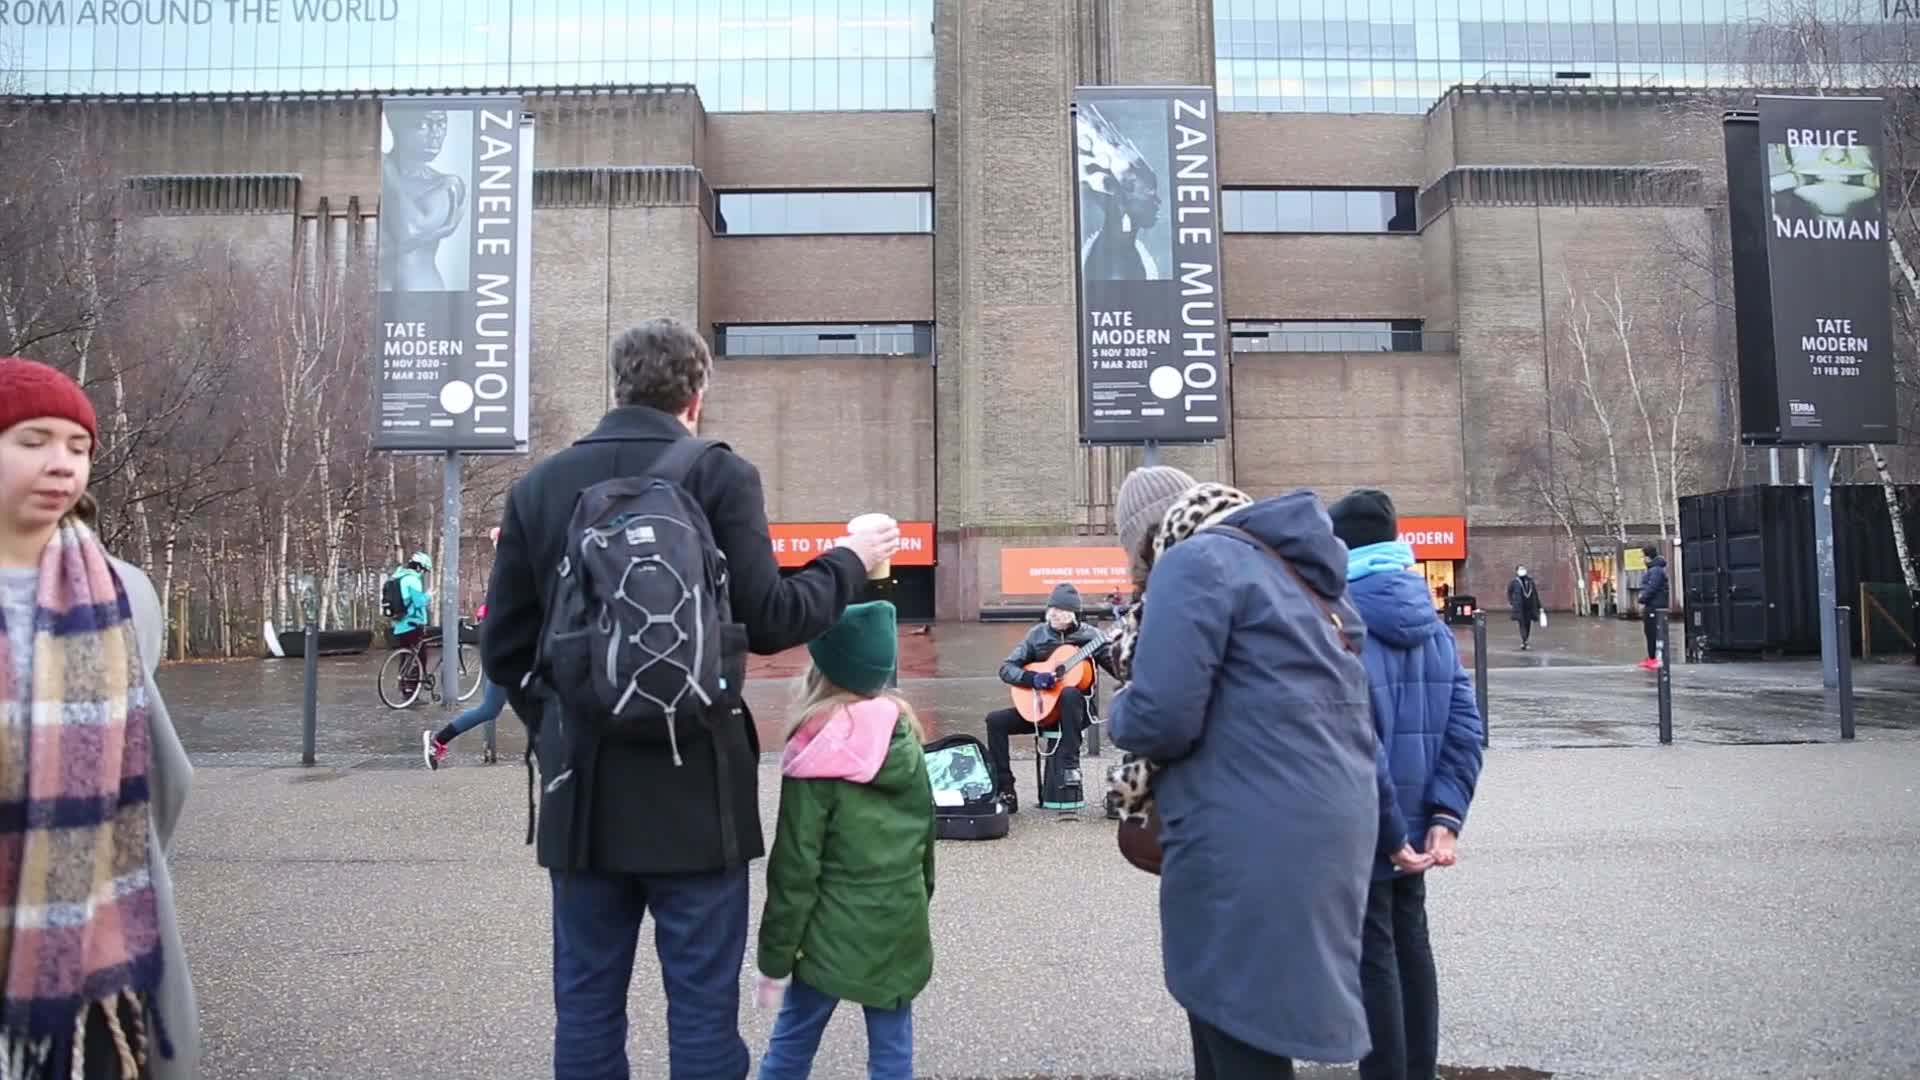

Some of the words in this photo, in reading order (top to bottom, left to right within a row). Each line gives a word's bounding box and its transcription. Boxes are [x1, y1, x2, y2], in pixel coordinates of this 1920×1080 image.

[76, 0, 213, 25] AROUND
[224, 0, 280, 24] THE
[292, 0, 399, 22] WORLD
[1787, 128, 1858, 149] BRUCE
[1174, 98, 1212, 244] ZANELE
[478, 110, 512, 255] ZANELE
[1776, 218, 1880, 241] NAUMAN
[1091, 311, 1133, 327] TATE
[1816, 318, 1852, 334] TATE
[384, 322, 426, 338] TATE
[1091, 329, 1171, 345] MODERN
[384, 340, 463, 356] MODERN
[1180, 262, 1218, 423] MUHOLI
[1801, 336, 1868, 352] MODERN
[473, 273, 510, 434] MUHOLI
[1100, 348, 1121, 357] NOV
[1816, 355, 1833, 364] OCT
[392, 359, 413, 368] NOV
[1101, 361, 1124, 369] MAR
[392, 371, 414, 380] MAR
[792, 539, 810, 552] TO
